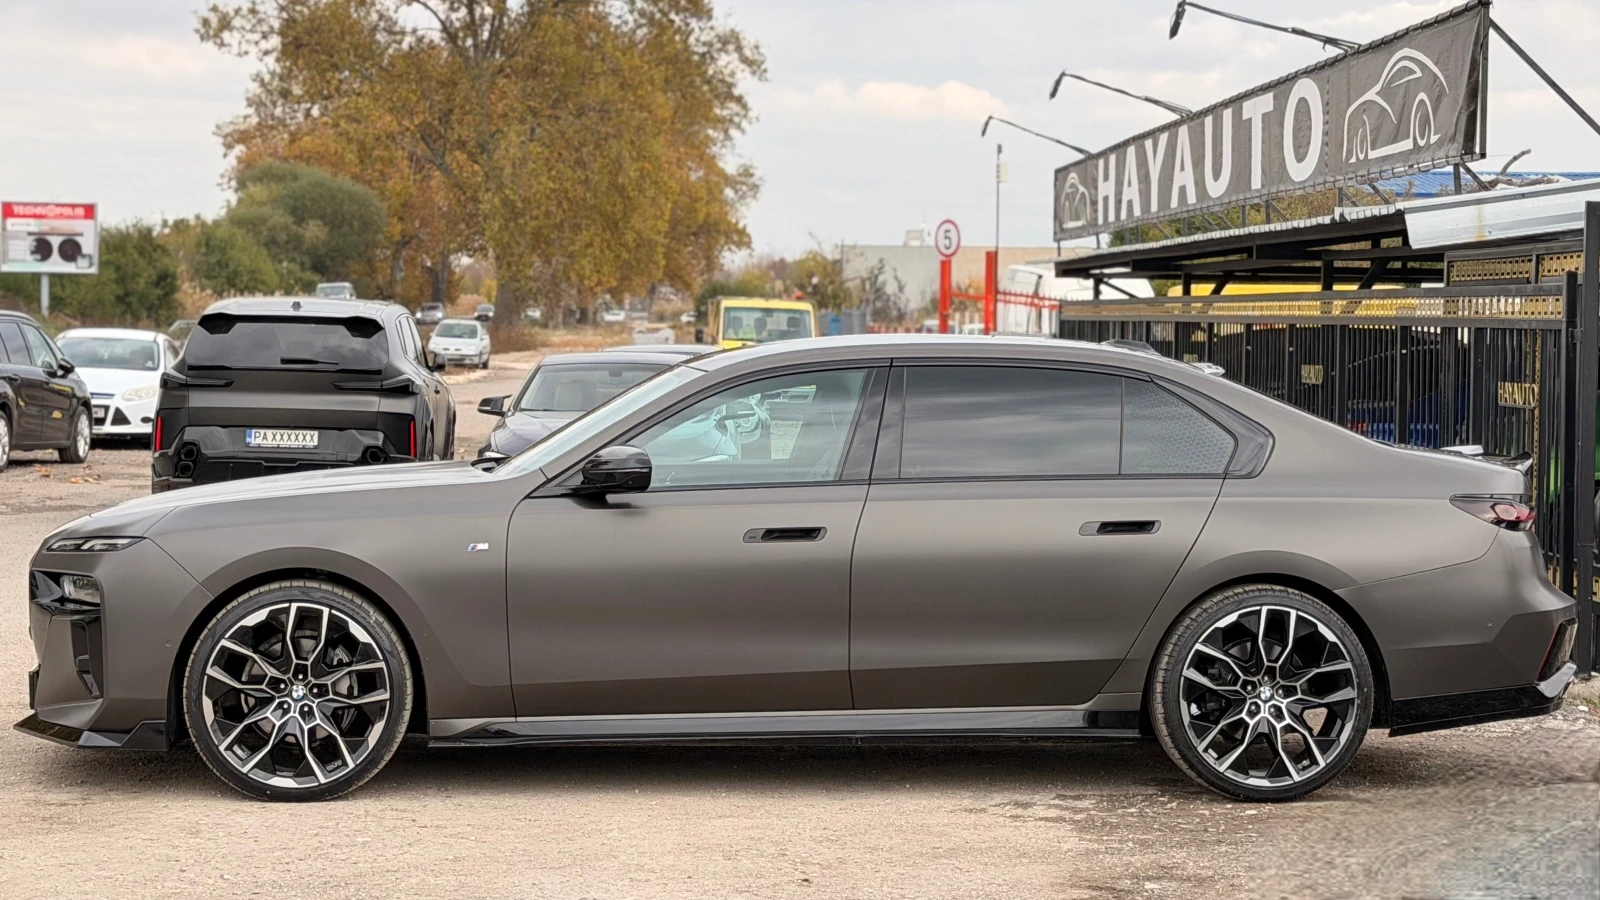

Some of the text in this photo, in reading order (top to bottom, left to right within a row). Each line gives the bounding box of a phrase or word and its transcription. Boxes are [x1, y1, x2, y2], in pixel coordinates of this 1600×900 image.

[1098, 78, 1323, 225] HAYAUTO
[943, 229, 952, 250] 5
[1498, 381, 1537, 406] HAYAUTO
